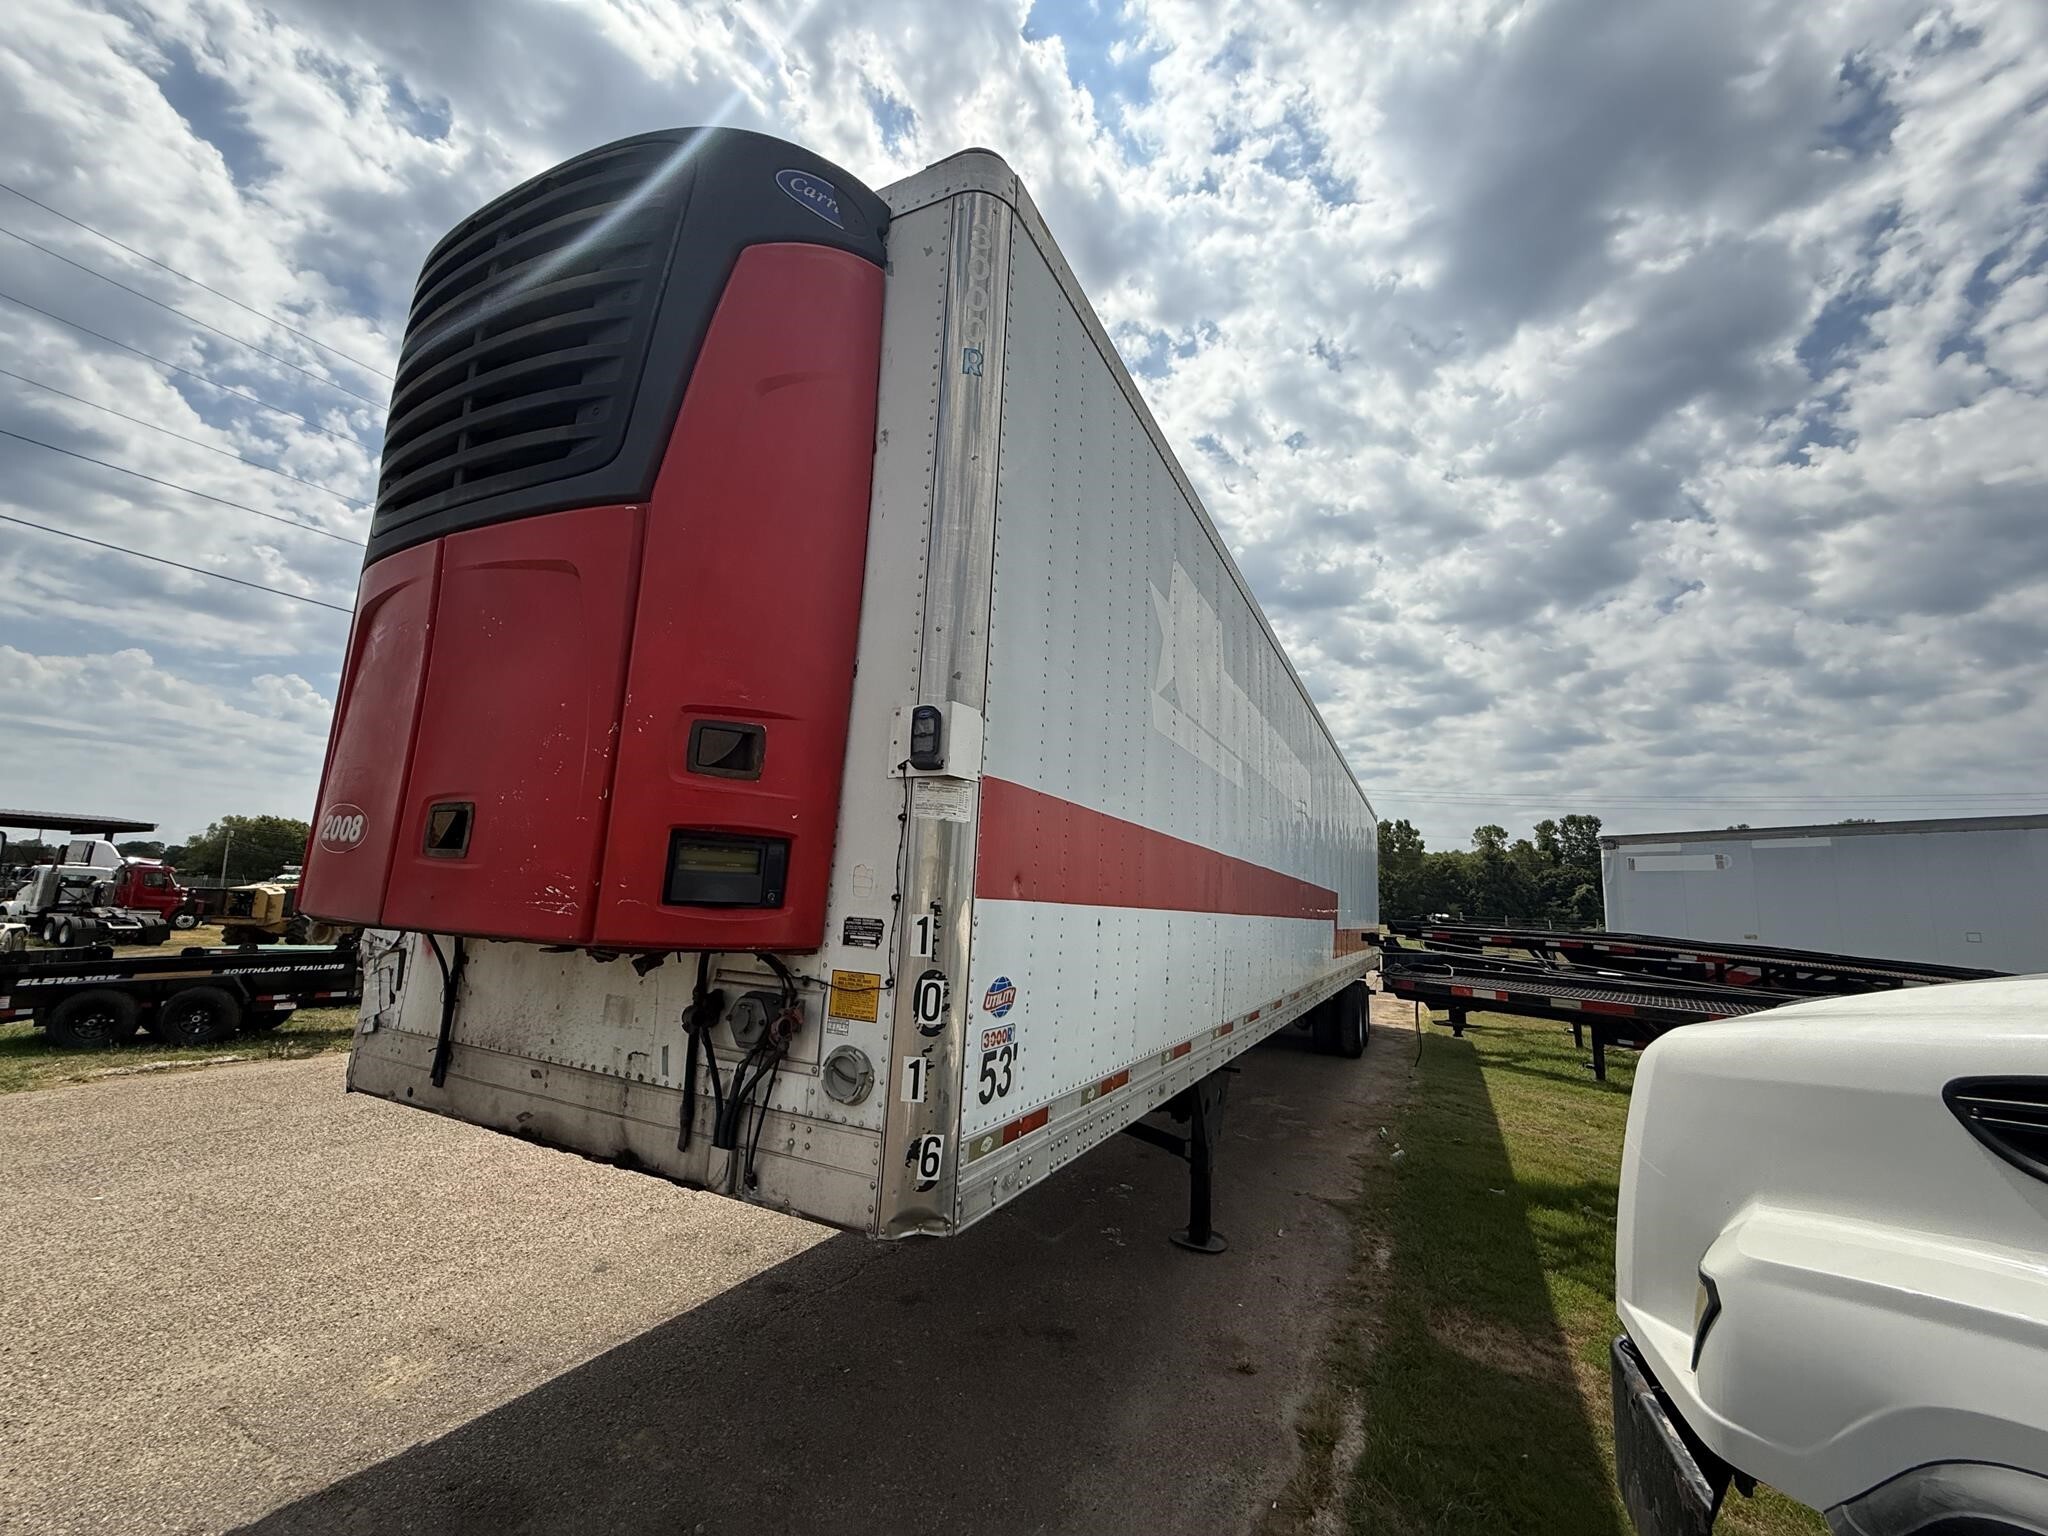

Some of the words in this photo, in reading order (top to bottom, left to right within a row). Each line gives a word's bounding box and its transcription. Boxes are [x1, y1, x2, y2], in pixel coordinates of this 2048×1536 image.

[321, 814, 364, 843] 2008
[223, 965, 291, 976] SOUTHLAND
[294, 963, 345, 972] TRAILERS
[985, 989, 1015, 1009] UTILITY
[983, 1027, 1013, 1049] 3000R
